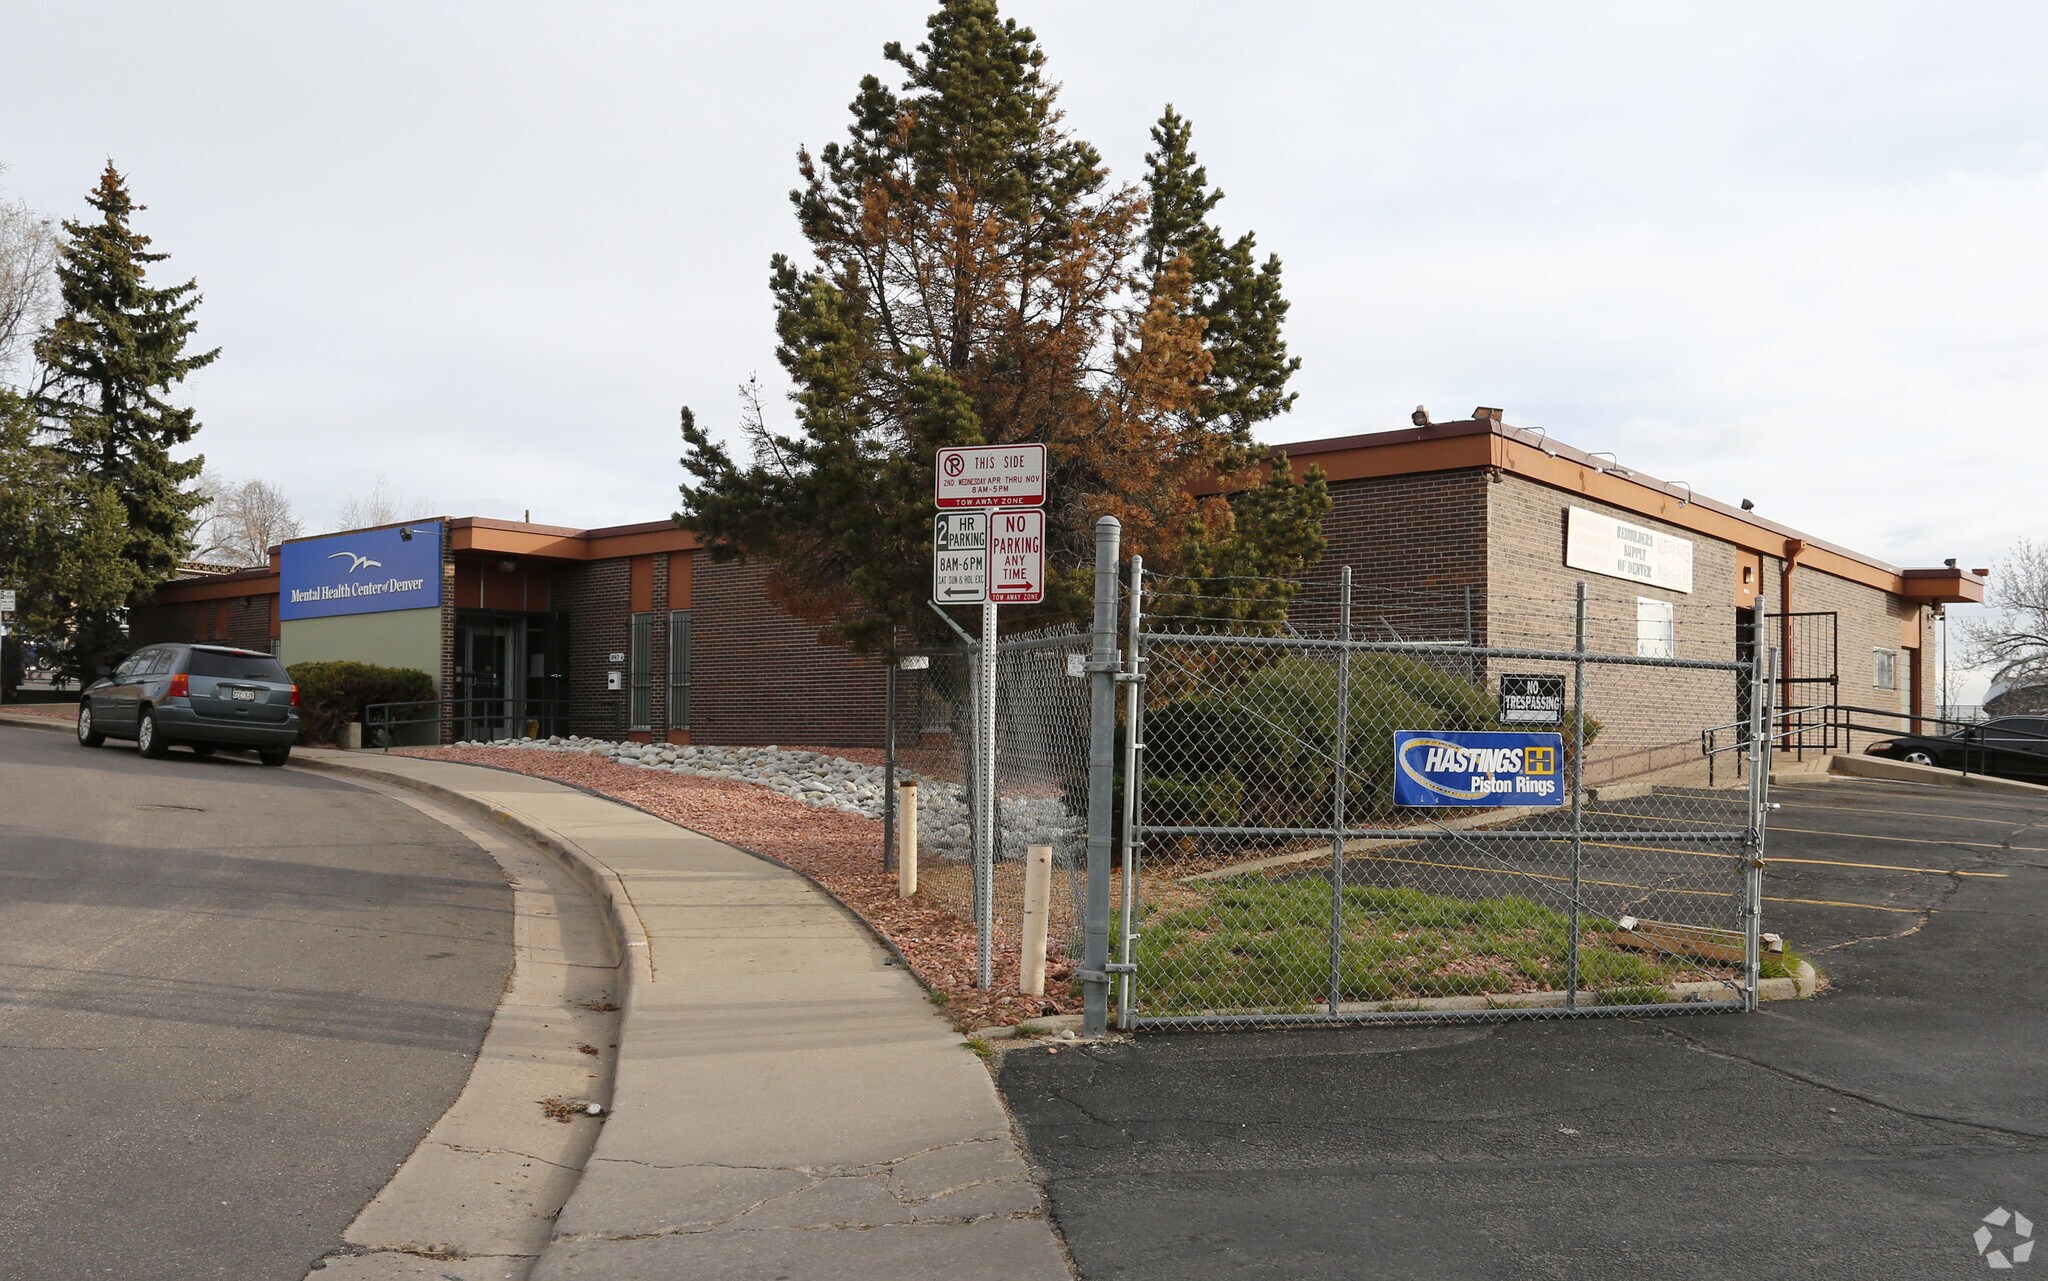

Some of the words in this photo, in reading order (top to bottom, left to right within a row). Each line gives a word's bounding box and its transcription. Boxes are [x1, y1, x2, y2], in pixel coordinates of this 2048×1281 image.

[975, 457, 995, 469] THIS
[1004, 455, 1025, 468] SIDE
[943, 479, 955, 487] 2ND
[958, 477, 986, 486] WEDNESDAY
[987, 476, 1001, 484] APR
[1005, 476, 1022, 484] THRU
[959, 517, 975, 531] HR
[1006, 515, 1026, 533] NO
[937, 521, 948, 546] 2
[950, 532, 985, 548] PARKING
[993, 536, 1039, 555] PARKING
[1623, 544, 1647, 562] SUPPLY
[1004, 555, 1026, 566] ANY
[1617, 558, 1627, 572] OF
[1627, 561, 1652, 578] DENVER
[1003, 568, 1027, 580] TIME
[291, 586, 320, 603] Mental
[322, 583, 351, 600] Health
[351, 581, 382, 597] Center
[382, 581, 390, 593] of
[389, 578, 424, 593] Denver
[1527, 680, 1539, 695] NO
[1505, 695, 1560, 710] TRESPASSING
[1425, 747, 1524, 773] HASTINGS
[1471, 776, 1513, 794] Piston
[1515, 776, 1556, 797] Rings
